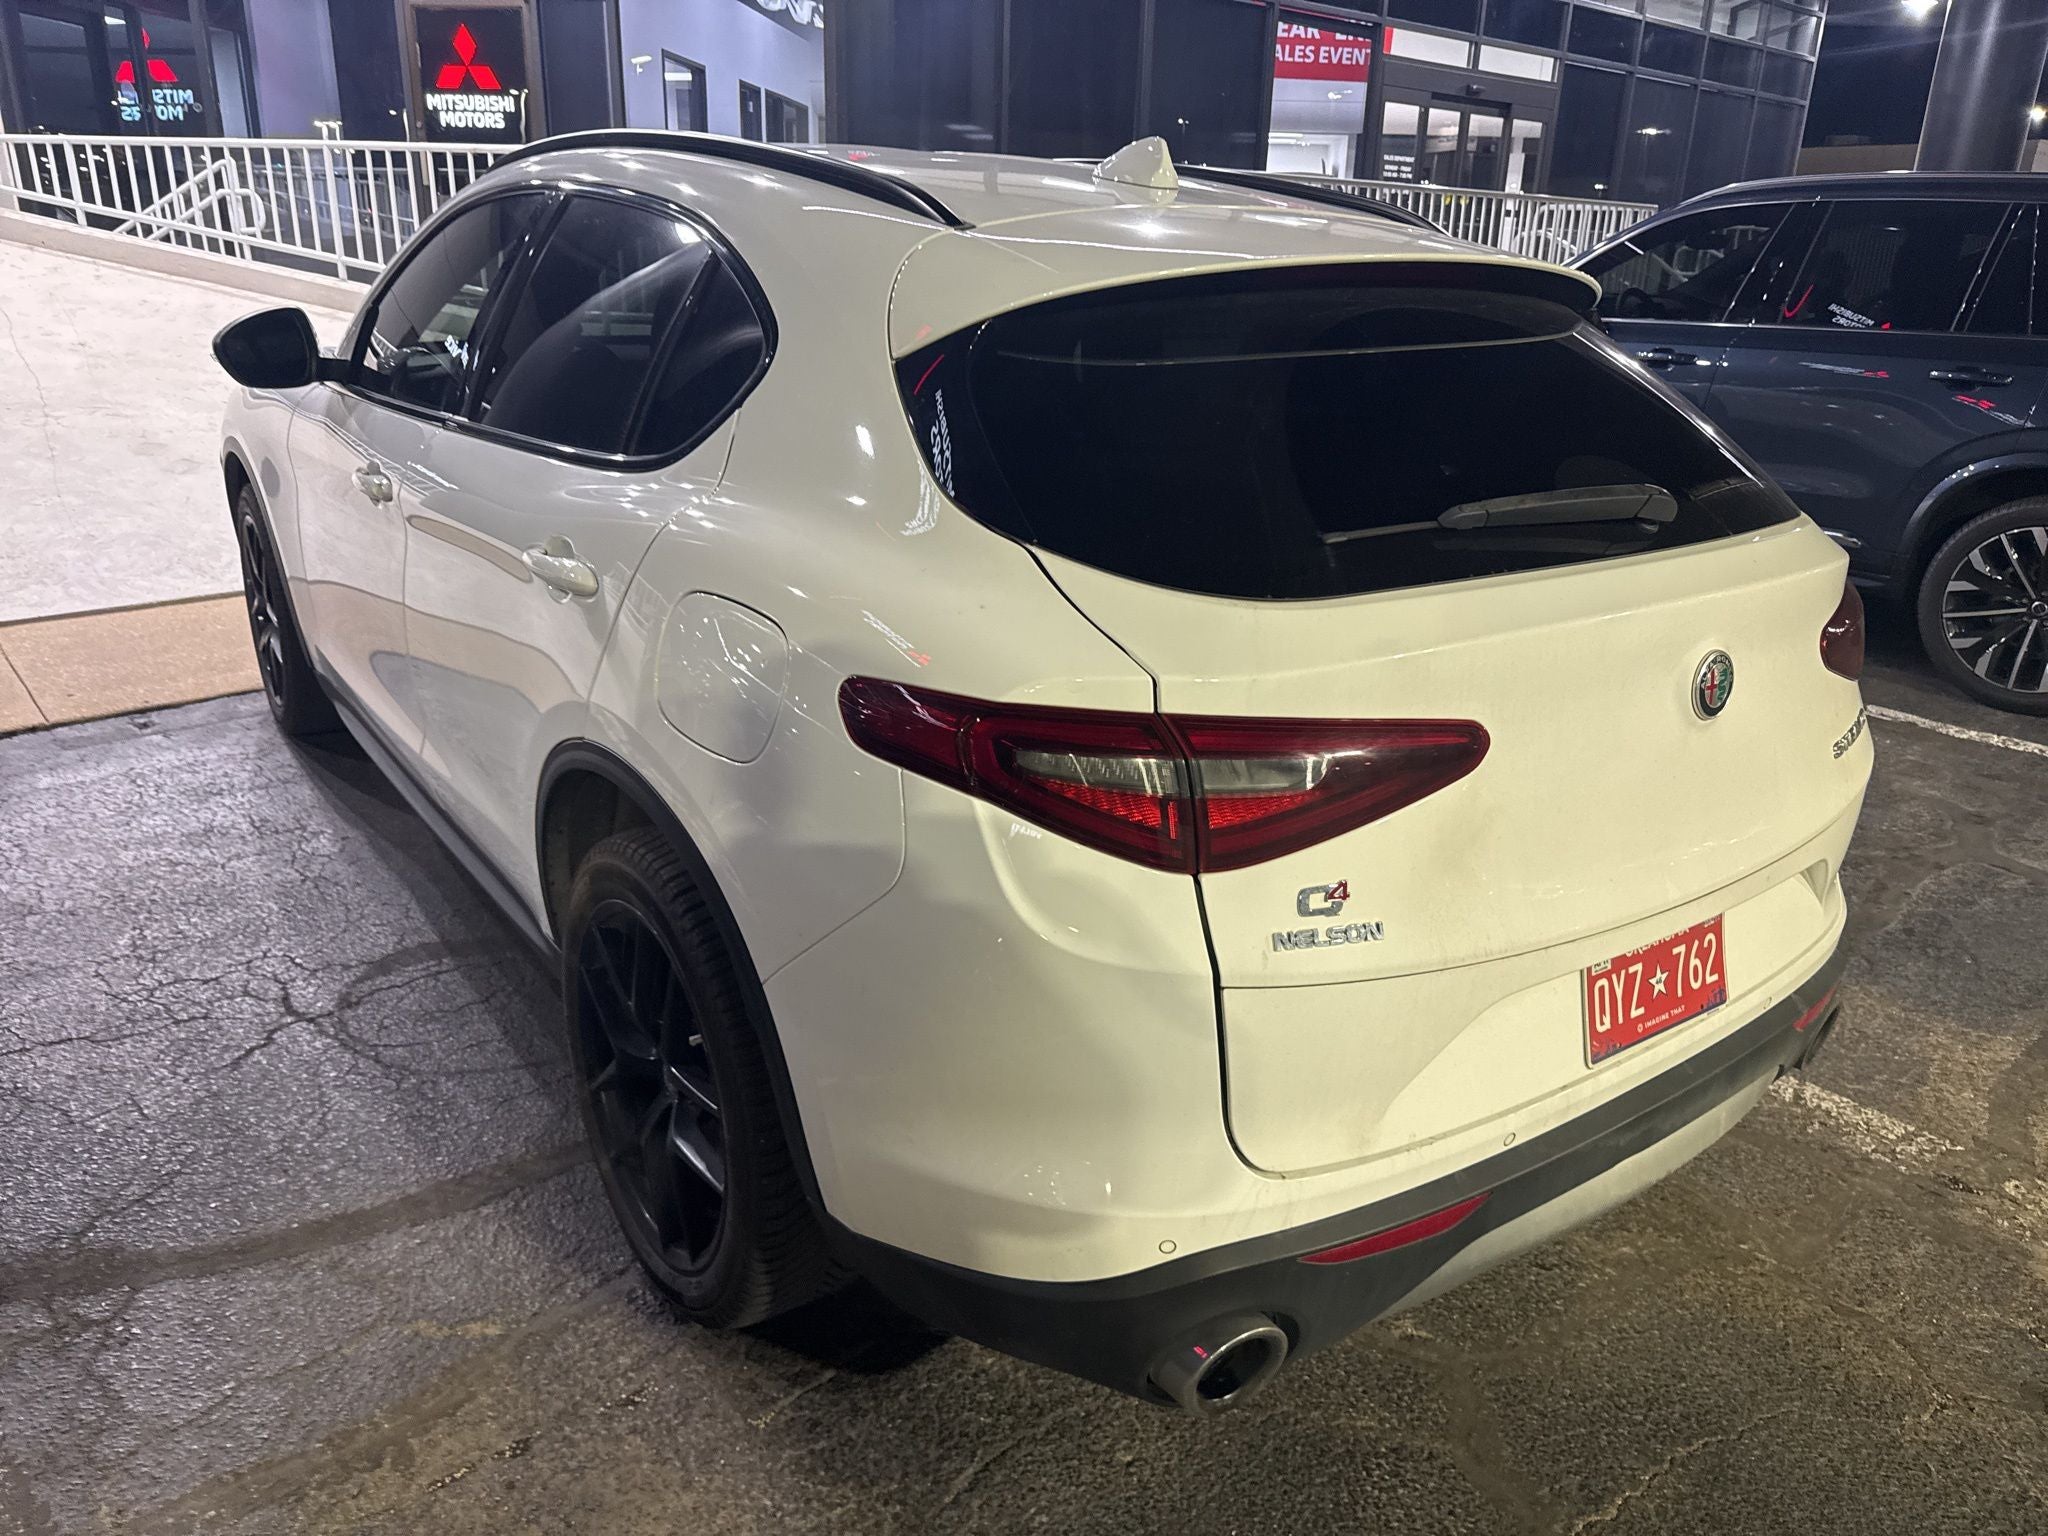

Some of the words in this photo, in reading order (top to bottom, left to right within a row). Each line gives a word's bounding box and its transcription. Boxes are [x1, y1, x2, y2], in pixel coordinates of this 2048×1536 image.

[426, 93, 515, 112] MITSUBISHI
[440, 111, 506, 129] MOTORS
[1272, 921, 1384, 952] NELSON
[1593, 962, 1645, 1033] QYZ
[1672, 932, 1719, 998] 762
[1644, 1009, 1669, 1028] IMAGINE
[1670, 1004, 1686, 1018] THAT
